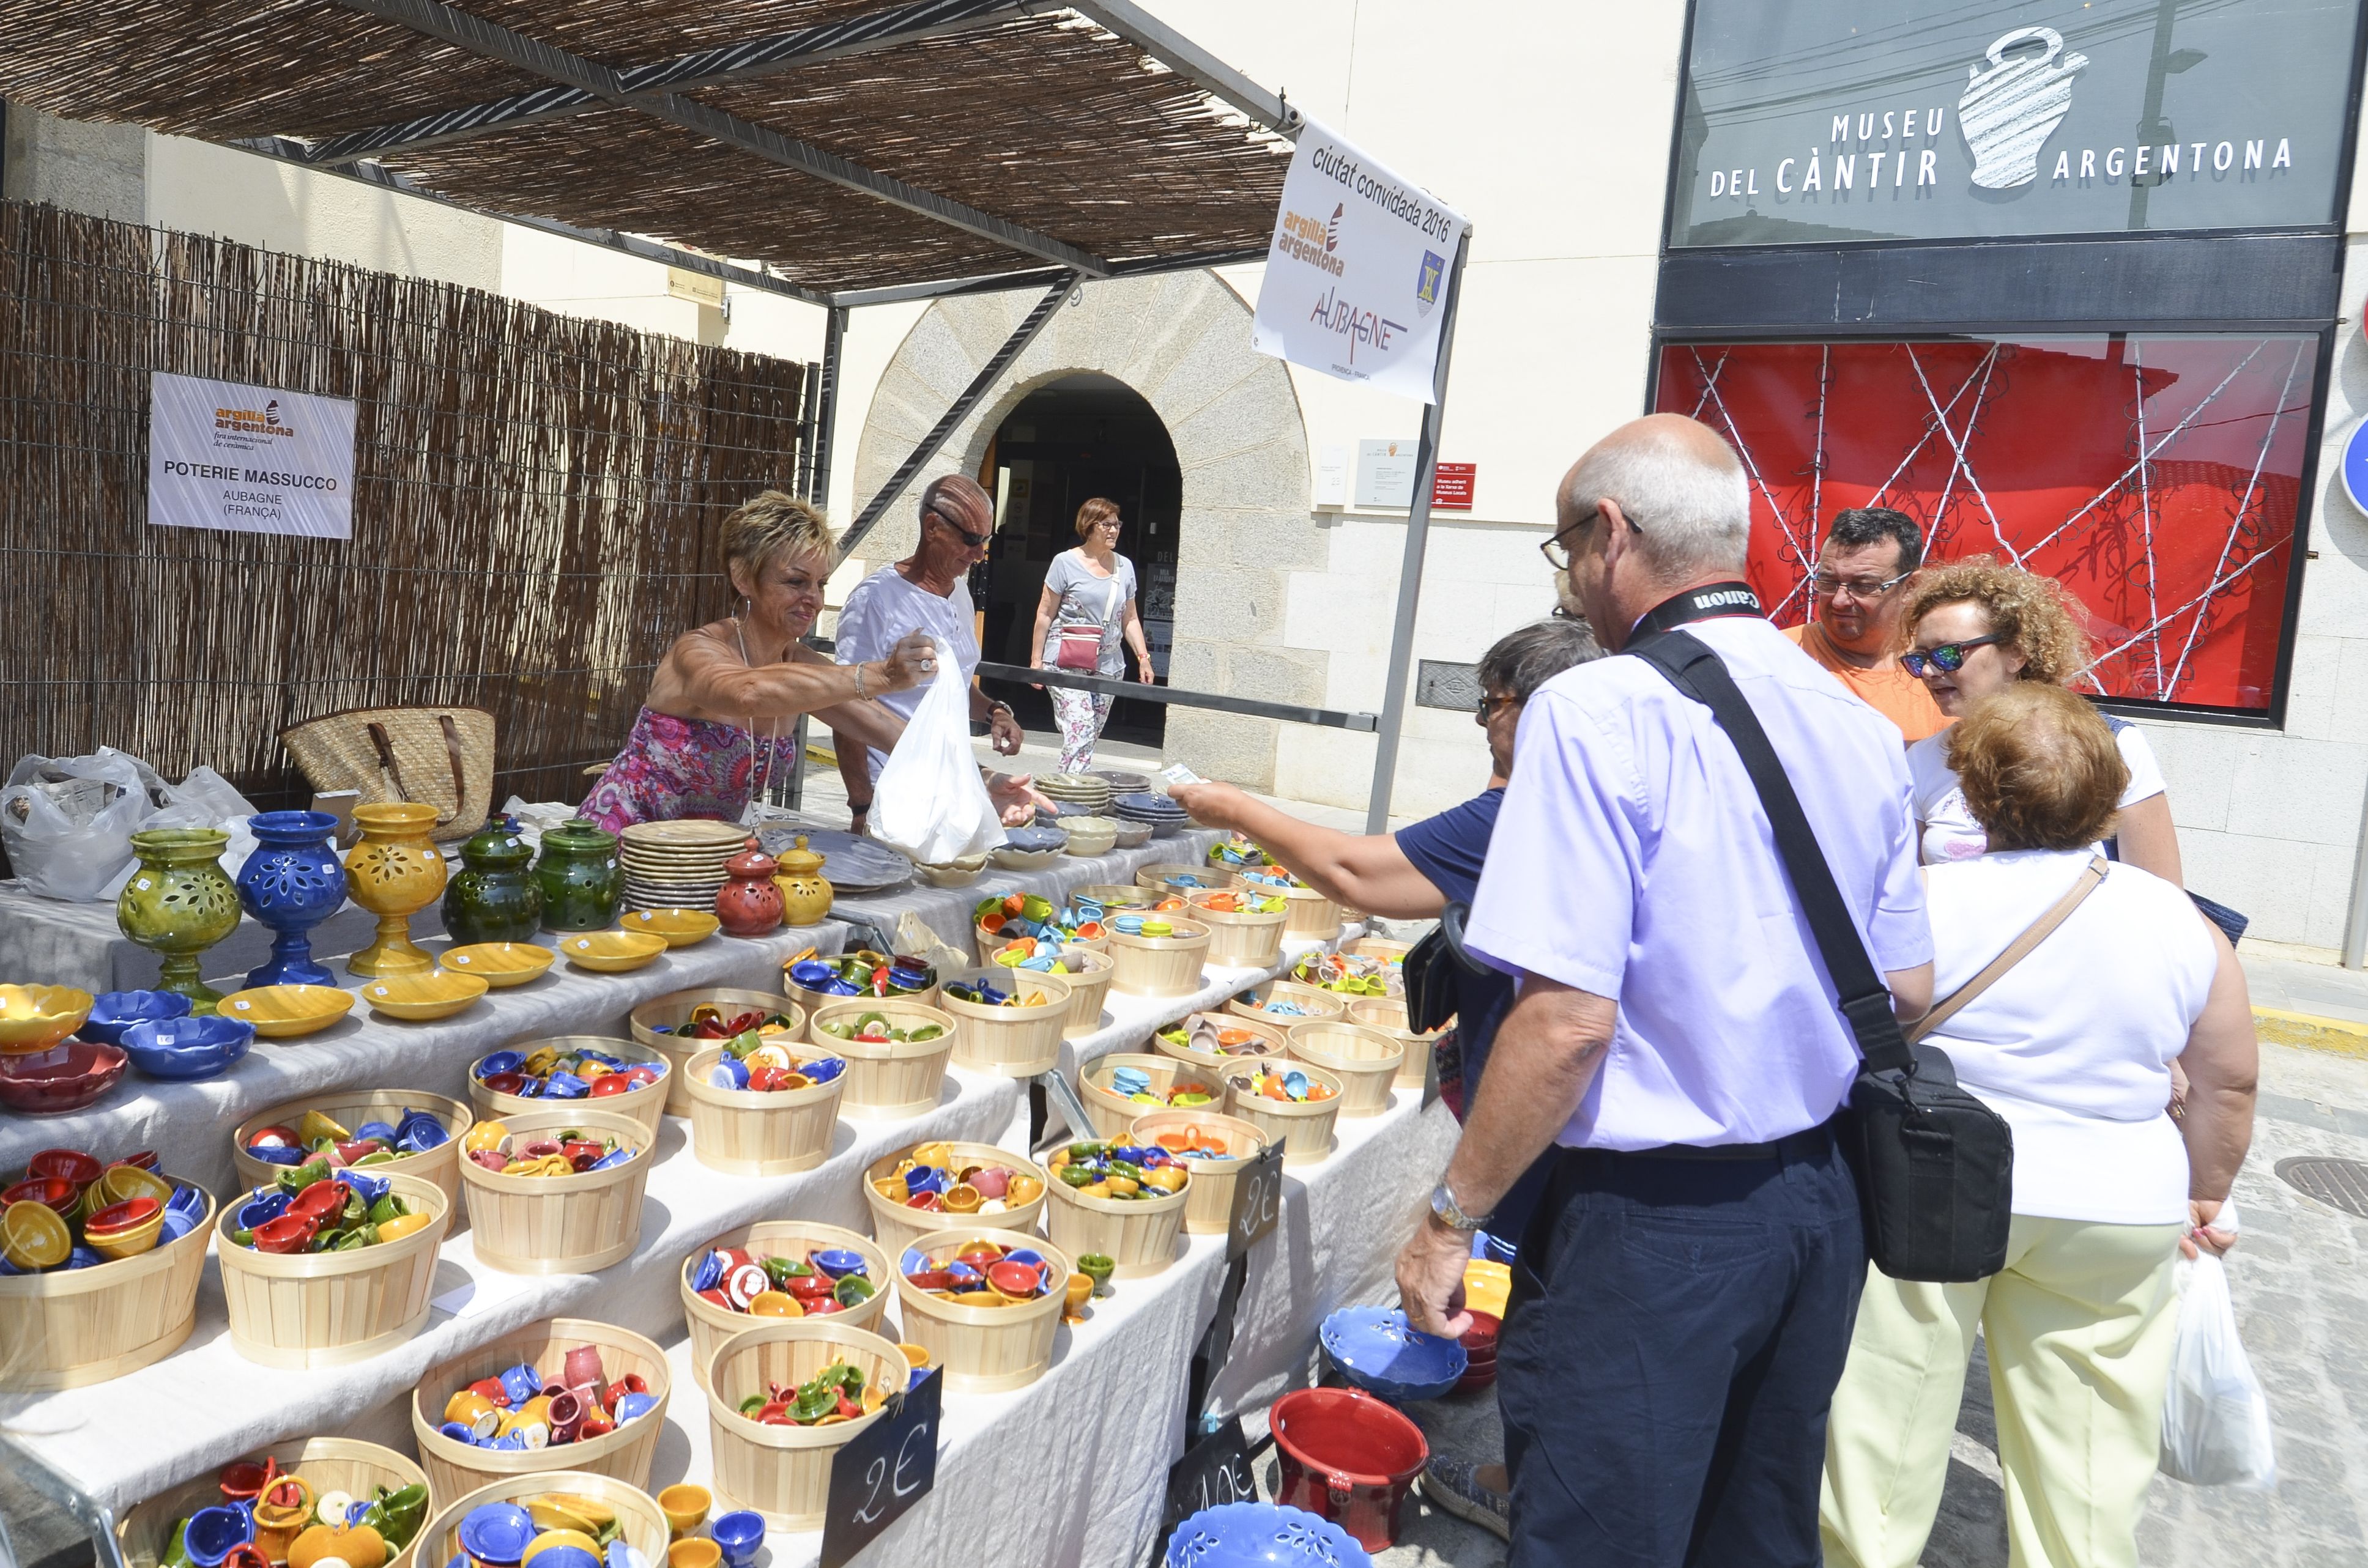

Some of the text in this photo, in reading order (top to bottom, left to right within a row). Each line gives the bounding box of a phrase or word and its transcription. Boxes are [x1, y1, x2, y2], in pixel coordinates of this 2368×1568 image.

[1831, 108, 1943, 142] MUSEU
[1710, 138, 2291, 197] DEL CÀNTIR ARGENTONA
[1312, 145, 1451, 243] ciutat convidada 2016
[1284, 210, 1327, 246] argillà
[1279, 232, 1344, 278] argentona
[1310, 286, 1408, 364] AUBAGNE
[215, 408, 265, 423] argillà
[215, 418, 294, 437] argentona
[214, 431, 273, 445] fira internacional
[223, 442, 254, 451] ceràmica
[164, 460, 337, 491] POTERIE MASSUCCO
[223, 490, 282, 505] AUBAGNE
[223, 504, 281, 520] (FRANÇA)
[1693, 590, 1760, 610] Canon
[1239, 1170, 1278, 1237] 2€
[853, 1423, 927, 1524] 2€
